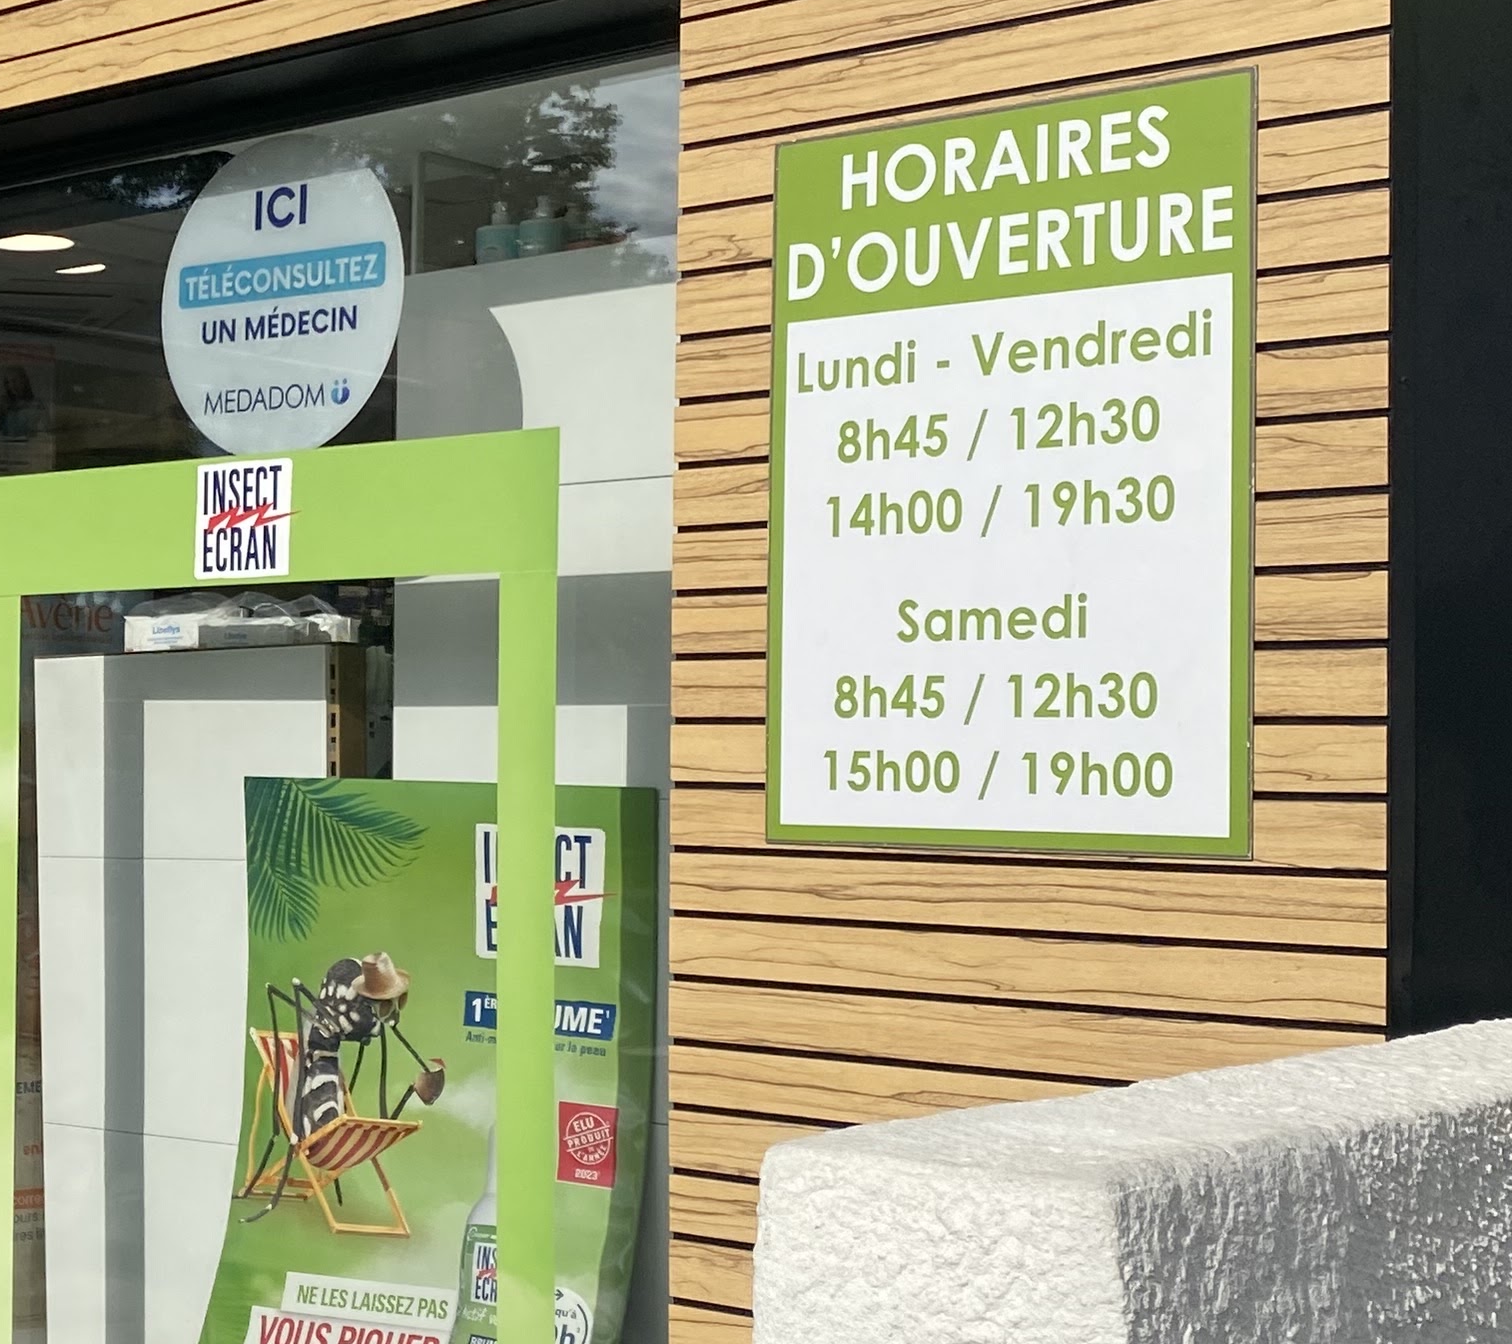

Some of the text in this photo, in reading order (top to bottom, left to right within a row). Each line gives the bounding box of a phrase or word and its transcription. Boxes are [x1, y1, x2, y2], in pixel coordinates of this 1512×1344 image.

[841, 104, 1171, 211] HORAIRES
[254, 183, 308, 231] ICI
[787, 185, 1235, 302] D'OUVERTURE
[185, 253, 378, 302] TÉLÉCONSULTEZ
[202, 304, 358, 344] UN MÉDECIN
[797, 339, 917, 394] Lundi
[971, 308, 1214, 377] Vendredi
[203, 382, 325, 416] MEDADOM
[837, 412, 949, 464] 8h45
[1010, 394, 1162, 452] 12h30
[203, 464, 283, 516] INSECT
[826, 487, 964, 539] 14h00
[1023, 474, 1176, 531] 19h30
[202, 523, 277, 573] ECRAN
[897, 592, 1089, 644] Samedi
[833, 672, 946, 721] 8h45
[1006, 671, 1159, 721] 12h30
[822, 749, 961, 795] 15h00
[1021, 751, 1175, 800] 19h00
[566, 1128, 610, 1149] PRODUIT
[572, 1116, 595, 1133] ELU
[297, 1284, 449, 1320] NE LES LAISSEZ PAS
